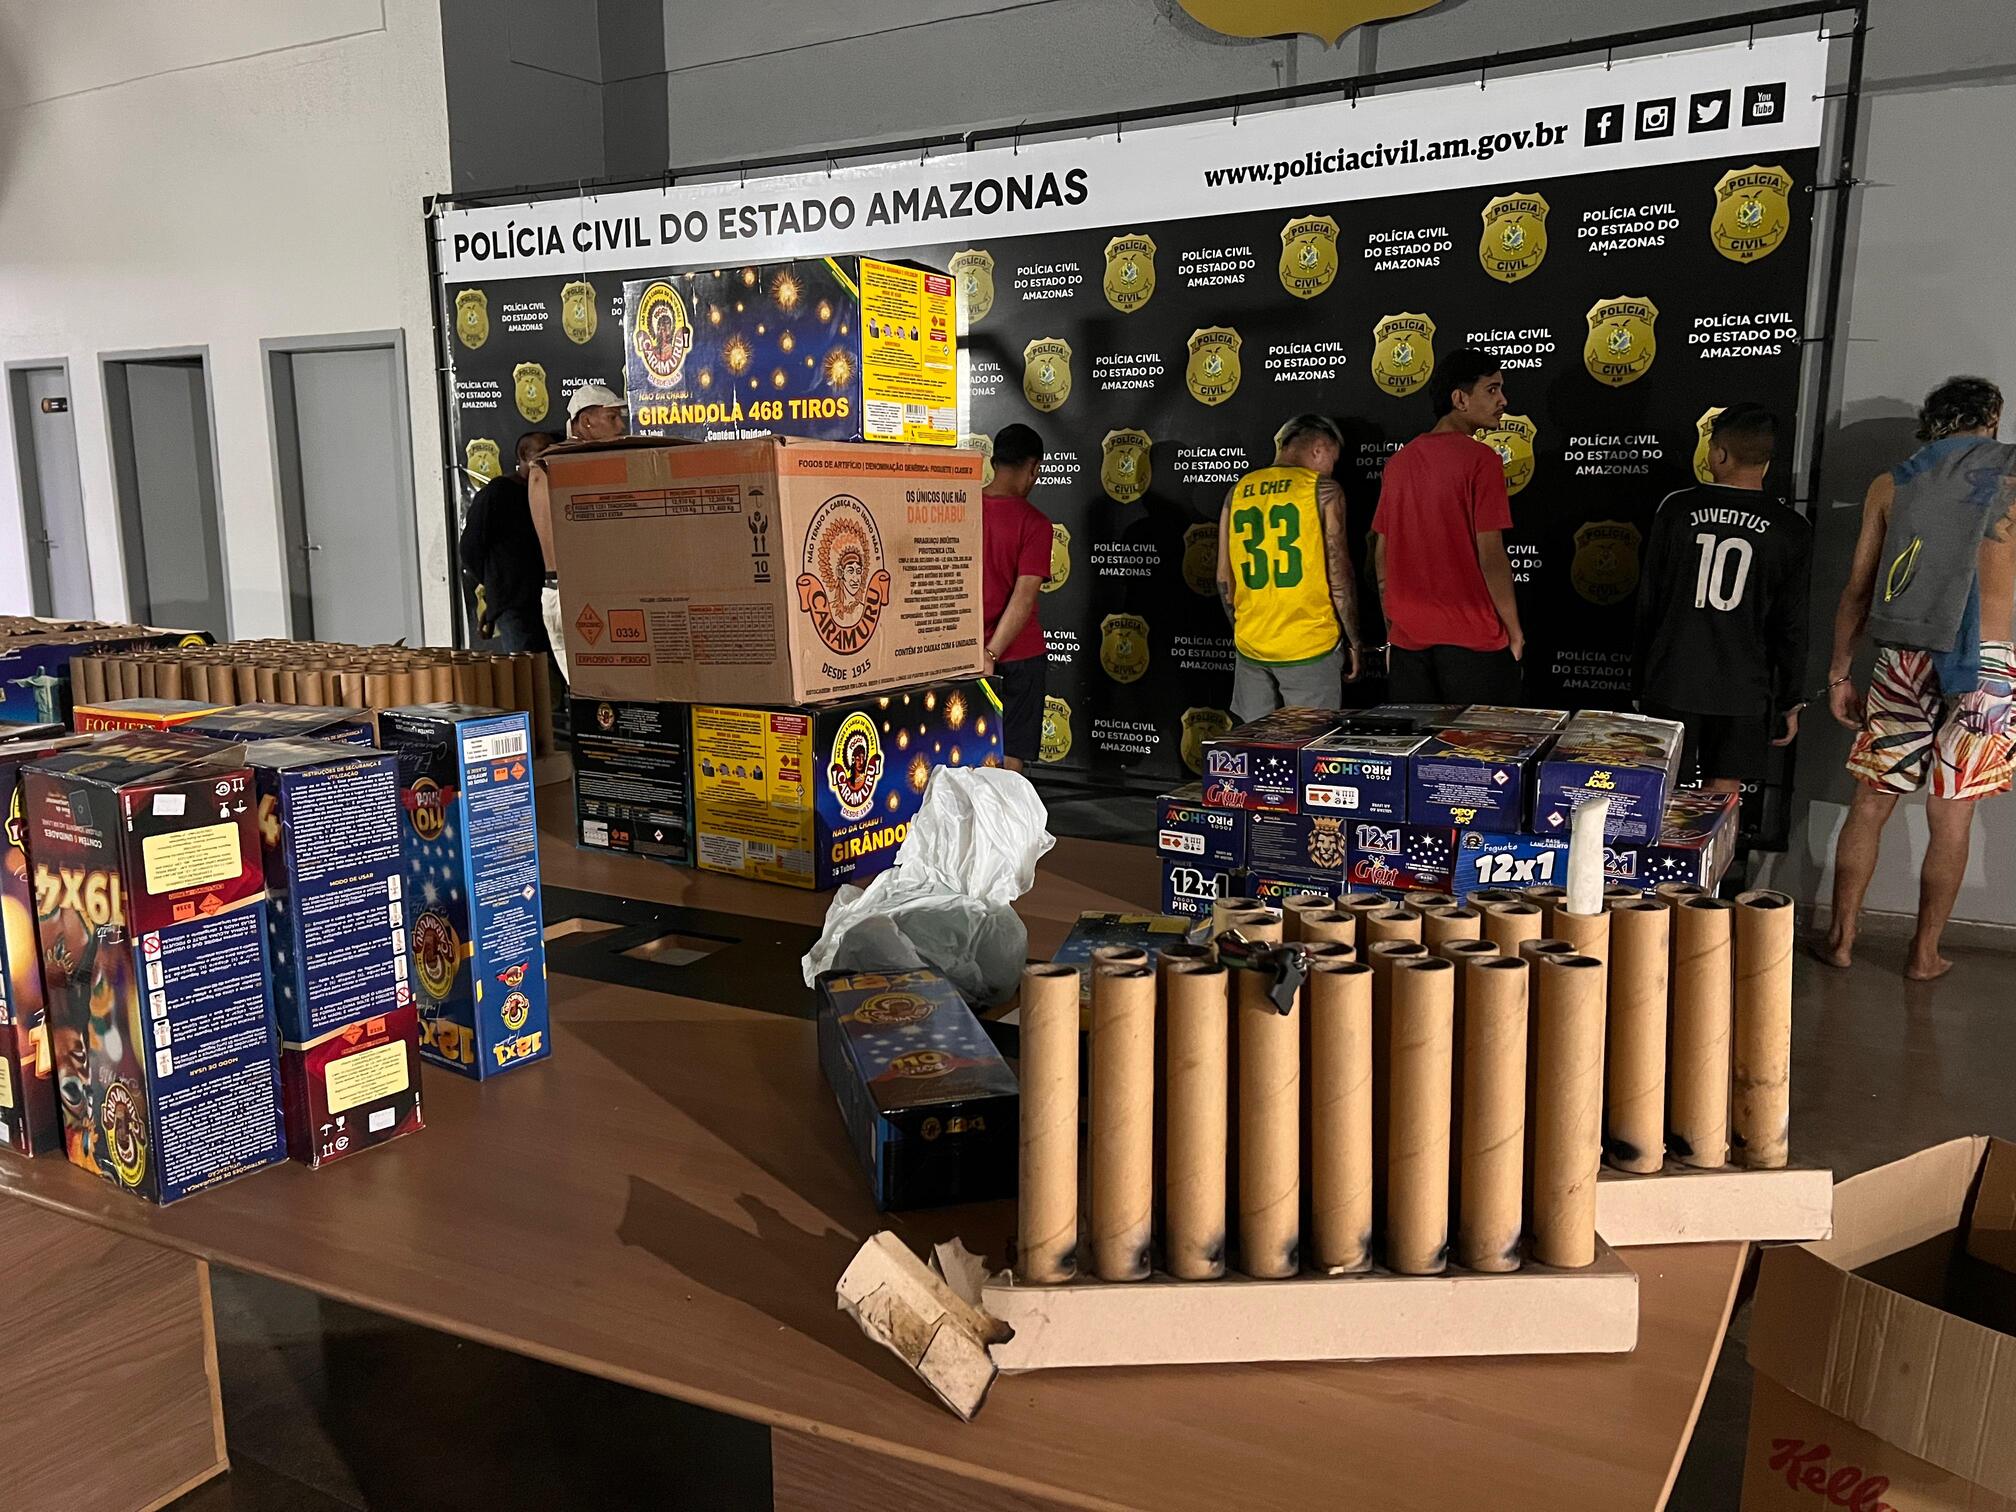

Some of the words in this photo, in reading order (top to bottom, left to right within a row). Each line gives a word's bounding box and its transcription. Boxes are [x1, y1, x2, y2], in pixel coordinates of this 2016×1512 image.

[1204, 119, 1568, 188] www.policiacivil.am.gov.br
[454, 220, 565, 262] POLÍCIA
[573, 217, 651, 252] CIVIL
[660, 211, 708, 245] DO
[719, 196, 855, 240] ESTADO
[866, 168, 1088, 226] AMAZONAS
[1583, 206, 1636, 222] POLÍCIA
[1639, 203, 1676, 216] CIVIL
[1369, 229, 1415, 244] POLÍCIA
[1417, 227, 1449, 239] CIVIL
[1578, 226, 1598, 238] DO
[1601, 221, 1654, 235] ESTADO
[1658, 218, 1679, 230] DO
[1364, 248, 1382, 258] DO
[1385, 243, 1431, 256] ESTADO
[1434, 241, 1452, 251] DO
[1589, 235, 1665, 253] AMAZONAS
[1182, 248, 1223, 261] POLÍCIA
[1225, 246, 1252, 257] CIVIL
[1017, 264, 1053, 276] POLÍCIA
[1055, 262, 1080, 272] CIVIL
[1178, 265, 1194, 275] DO
[1196, 261, 1237, 273] ESTADO
[1239, 259, 1255, 269] DO
[1374, 256, 1440, 271] AMAZONAS
[1014, 279, 1028, 289] DO
[1030, 276, 1066, 287] ESTADO
[1068, 275, 1083, 284] DO
[1187, 274, 1245, 287] AMAZONAS
[1022, 288, 1074, 300] AMAZONAS
[1694, 313, 1751, 328] POLÍCIA
[1754, 312, 1793, 324] CIVIL
[1467, 329, 1516, 343] POLÍCIA
[1518, 328, 1552, 339] CIVIL
[1688, 333, 1710, 344] DO
[1714, 329, 1771, 342] ESTADO
[1774, 328, 1798, 343] DO
[642, 335, 684, 375] CARAMURU
[1269, 343, 1312, 355] POLÍCIA
[1314, 342, 1343, 352] CIVIL
[1700, 344, 1781, 358] AMAZONAS
[1096, 353, 1134, 365] POLÍCIA
[1135, 353, 1161, 363] CIVIL
[1265, 359, 1281, 369] DO
[1284, 357, 1327, 368] ESTADO
[1329, 355, 1346, 365] DO
[1093, 369, 1107, 378] DO
[1109, 367, 1147, 377] ESTADO
[1149, 366, 1164, 375] DO
[1274, 370, 1335, 382] AMAZONAS
[1101, 379, 1154, 390] AMAZONAS
[638, 401, 744, 426] GIRÂNDOLA
[748, 400, 783, 422] 468
[788, 397, 850, 421] TIROS
[706, 429, 735, 441] Contém
[739, 428, 772, 439] Unidade
[1570, 434, 1621, 446] POLÍCIA
[1625, 435, 1659, 445] CIVIL
[1177, 446, 1217, 458] POLÍCIA
[1219, 447, 1246, 457] CIVIL
[1565, 451, 1584, 461] DO
[1587, 450, 1638, 460] ESTADO
[1642, 449, 1662, 459] DO
[798, 460, 823, 468] FOGOS
[823, 460, 833, 468] DE
[834, 460, 862, 470] ARTIFÍCIO
[1173, 461, 1189, 471] DO
[1191, 460, 1231, 470] ESTADO
[1233, 460, 1249, 469] DO
[1575, 465, 1648, 475] AMAZONAS
[1182, 473, 1239, 483] AMAZONAS
[905, 490, 916, 503] OS
[916, 488, 940, 503] ÚNICOS
[940, 491, 954, 503] QUE
[954, 489, 967, 503] NÃO
[1243, 483, 1258, 499] EL
[1259, 479, 1293, 496] CHEF
[1690, 507, 1771, 534] JUVENTUS
[807, 543, 815, 564] NÃO
[812, 514, 826, 541] TENDO
[829, 499, 851, 511] CABEÇA
[852, 502, 861, 513] DO
[859, 510, 874, 534] ÍNDIO
[871, 534, 879, 554] NÃO
[1233, 502, 1304, 590] 33
[754, 560, 769, 573] 10
[1695, 533, 1754, 612] 10
[811, 587, 880, 651] CARAMURU
[615, 627, 640, 638] 0336
[894, 646, 917, 657] CONTÉM
[916, 646, 923, 654] 20
[821, 662, 847, 680] DESDE
[851, 658, 872, 679] 1915
[1207, 749, 1248, 776] 12x1
[837, 764, 876, 805] CARAMURU
[415, 808, 445, 829] 110
[1356, 824, 1401, 854] 12x1
[840, 862, 856, 874] Tubos
[1475, 850, 1555, 884] 12x1
[1170, 867, 1229, 900] 12x1
